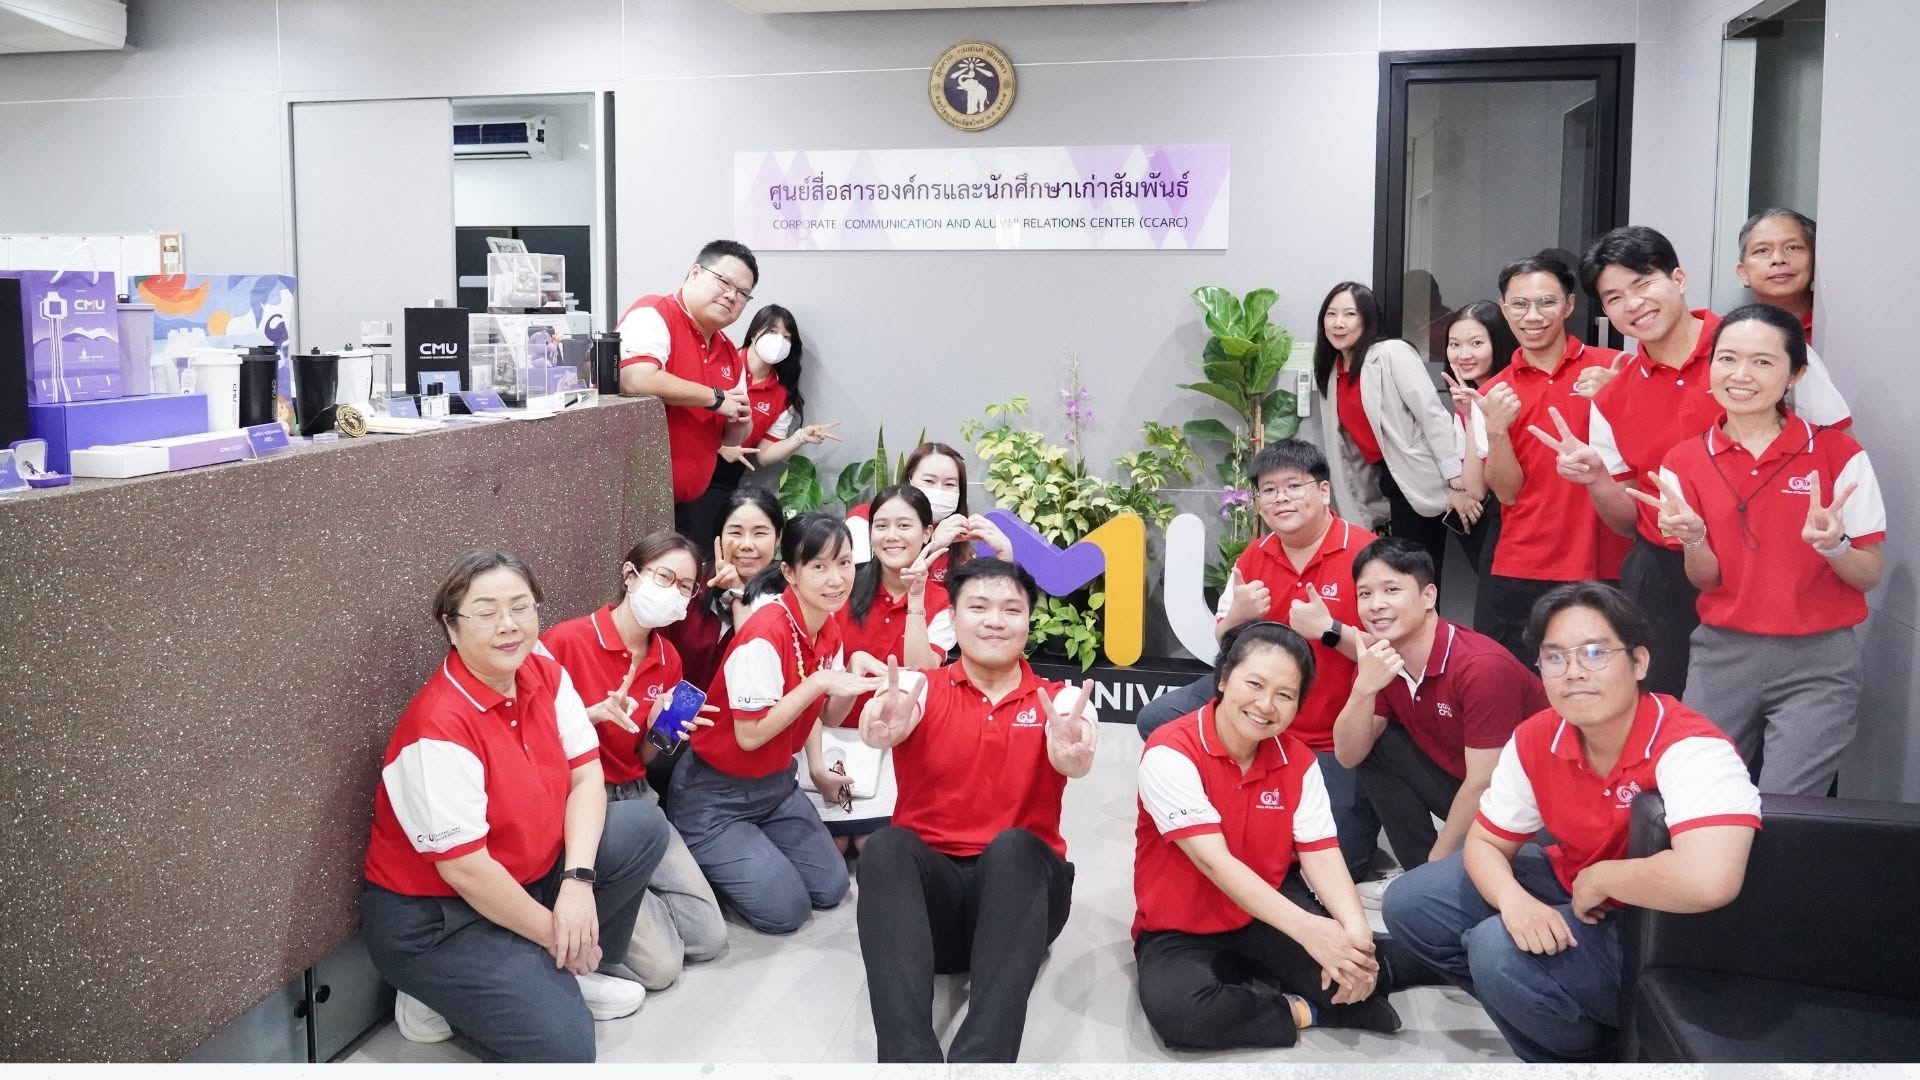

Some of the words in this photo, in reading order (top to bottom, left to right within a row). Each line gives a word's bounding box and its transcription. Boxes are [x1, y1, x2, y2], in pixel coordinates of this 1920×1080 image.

[769, 171, 1190, 210] ศูนย์สื่อสารองค์กรและนักศึกษาเก่าสัมพันธ์
[772, 219, 837, 230] CORPORATE
[844, 218, 942, 229] COMMUNICATION
[946, 218, 971, 229] AND
[974, 218, 1019, 229] ALU
[1023, 218, 1086, 229] RELATIONS
[1090, 218, 1135, 228] CENTER
[1139, 217, 1188, 229] (CCARC)
[73, 299, 105, 311] CMU
[419, 342, 458, 355] CMU
[1064, 678, 1184, 712] NIV
